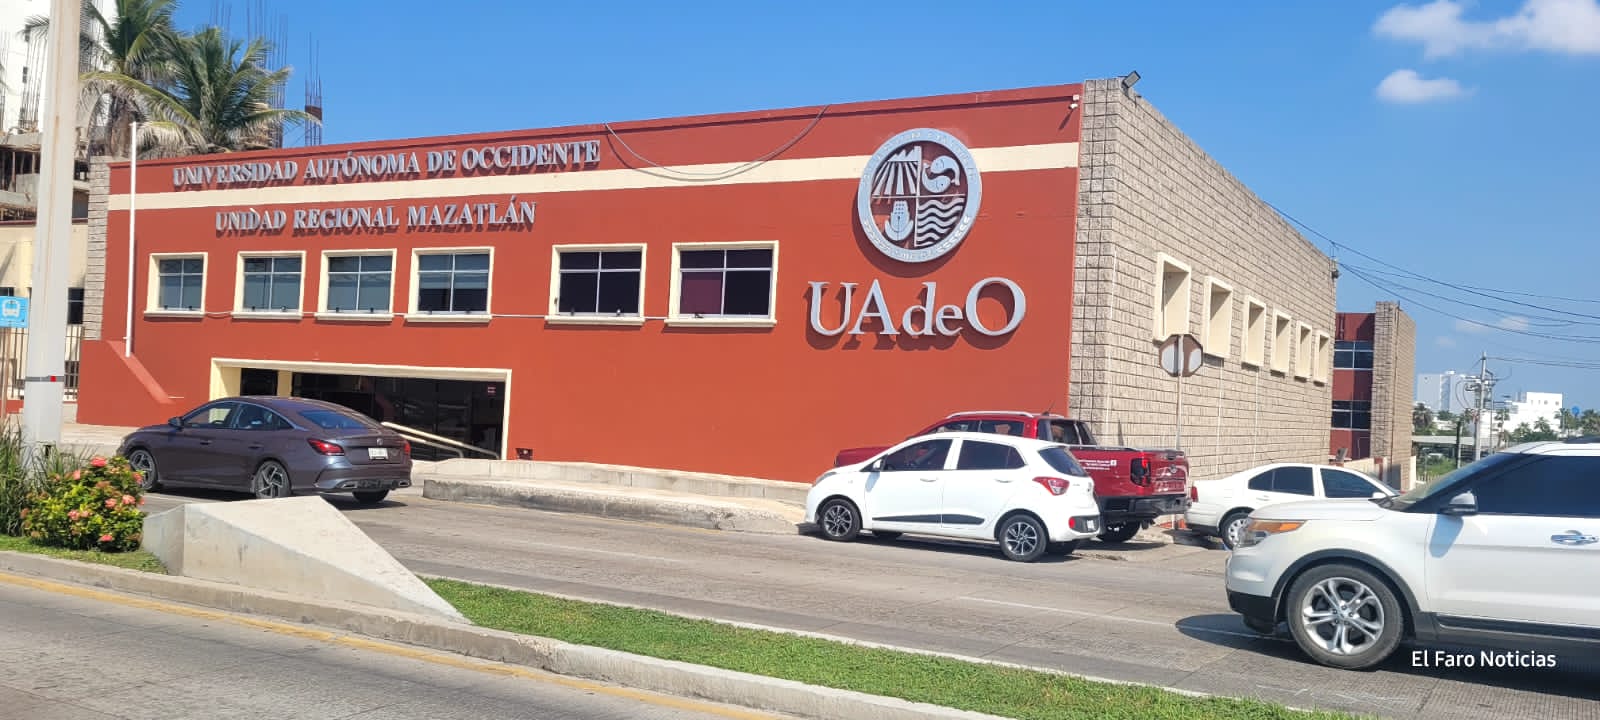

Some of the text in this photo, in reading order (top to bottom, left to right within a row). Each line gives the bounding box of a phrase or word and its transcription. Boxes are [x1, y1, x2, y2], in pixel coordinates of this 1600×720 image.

[173, 141, 600, 187] UNIVERSIDAD AUTÓNOMA DE OCCIDENTE
[215, 195, 536, 231] UNIDAD REGIONAL MAZATLÁN
[807, 276, 1027, 337] UAdeO
